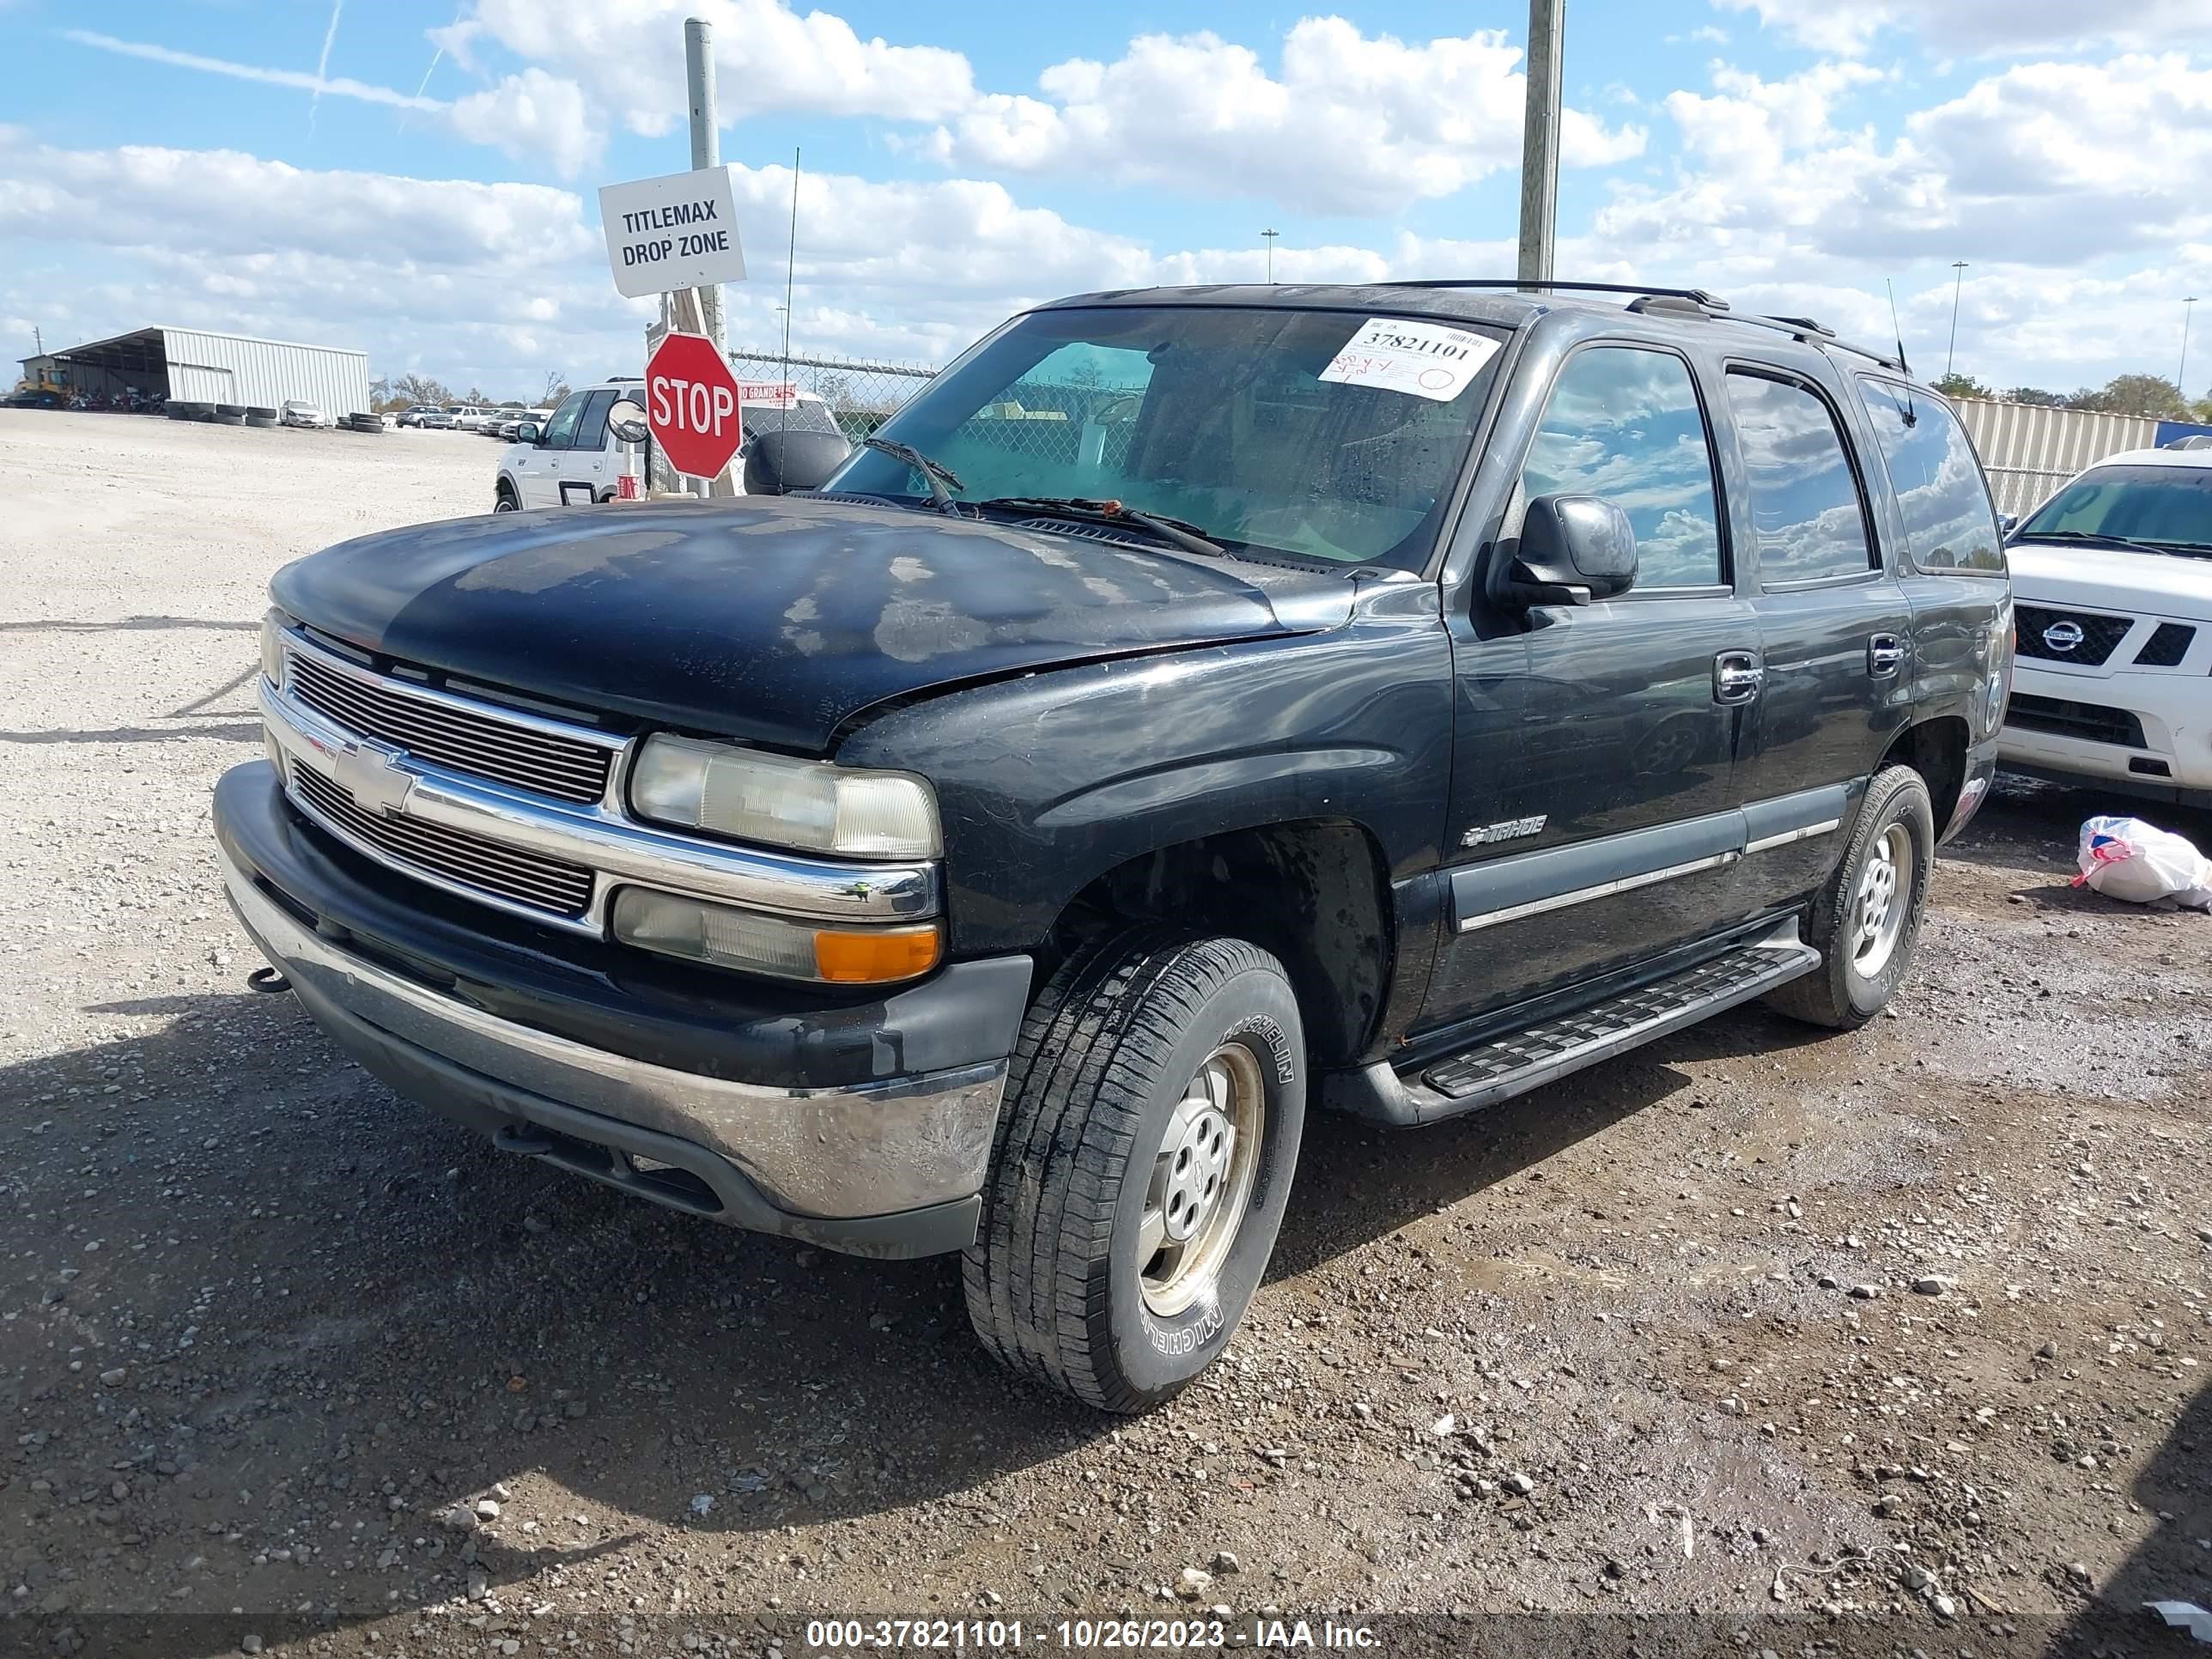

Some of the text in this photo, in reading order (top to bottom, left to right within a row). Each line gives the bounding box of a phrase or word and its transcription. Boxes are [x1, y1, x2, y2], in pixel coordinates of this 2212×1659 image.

[623, 199, 718, 234] TITLEMAX
[623, 230, 730, 266] DROP ZONE
[1364, 332, 1469, 362] 37821101
[652, 376, 734, 437] STOP
[749, 386, 777, 399] GRANDE
[2046, 630, 2078, 641] NISSAN
[1487, 815, 1548, 843] TAHOE
[1904, 857, 1929, 949] TOYO
[1138, 1294, 1224, 1355] MICHELIN
